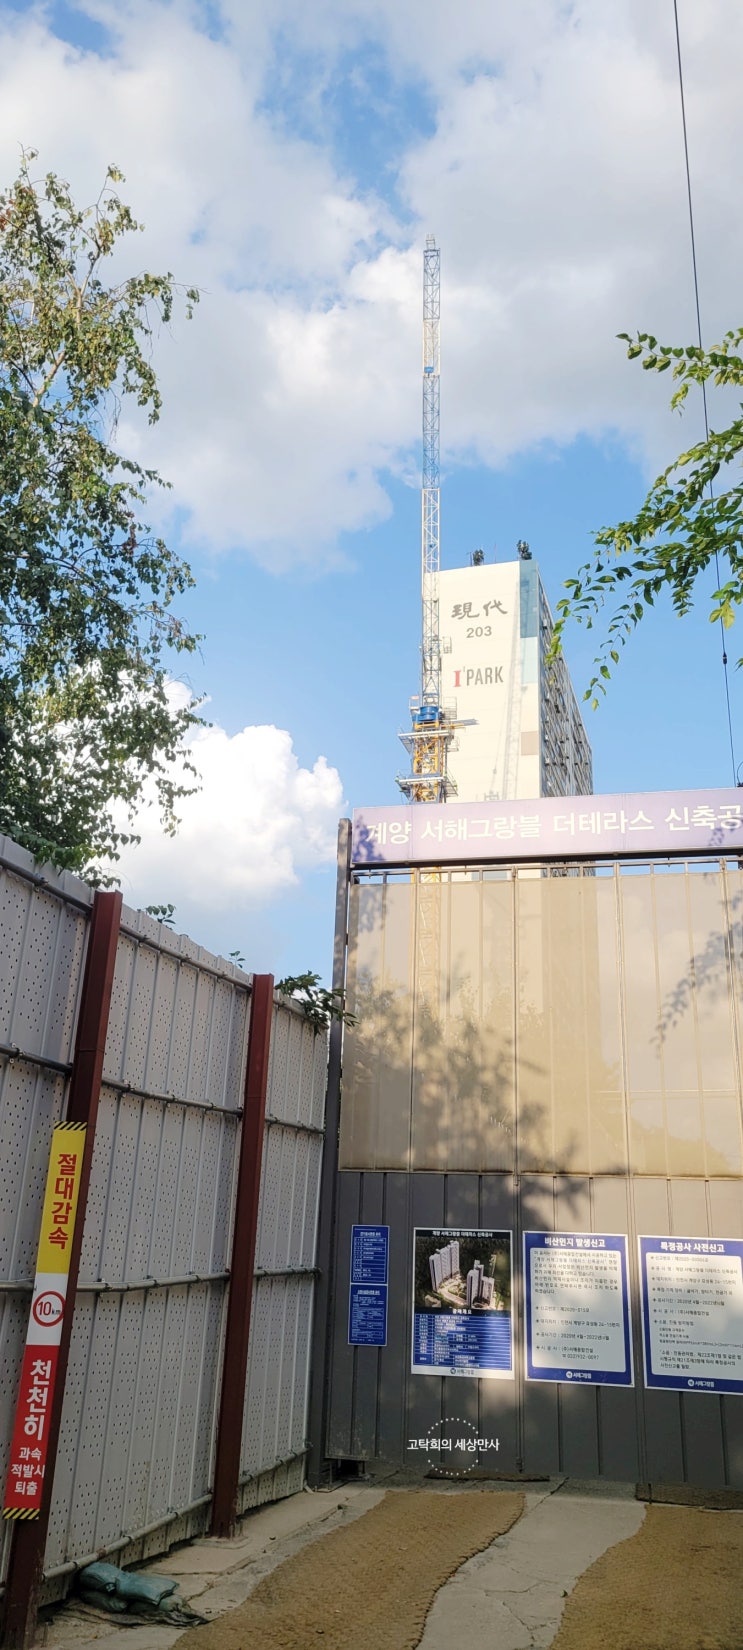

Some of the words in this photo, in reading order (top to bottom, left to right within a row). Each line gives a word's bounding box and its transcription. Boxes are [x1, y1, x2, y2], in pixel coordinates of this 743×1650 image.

[451, 599, 508, 620] 現代
[466, 625, 493, 639] 203
[365, 820, 412, 845] 계양
[420, 815, 542, 842] 서해그랑블
[553, 809, 655, 836] 더테라스
[48, 1153, 77, 1250] 절대감속
[576, 1238, 606, 1248] 발생신고
[660, 1242, 691, 1252] 특정공사
[693, 1243, 725, 1253] 사전신고
[24, 1359, 52, 1441] 천천히
[18, 1447, 42, 1461] 과속
[11, 1463, 46, 1479] 적발시
[14, 1481, 38, 1496] 퇴출
